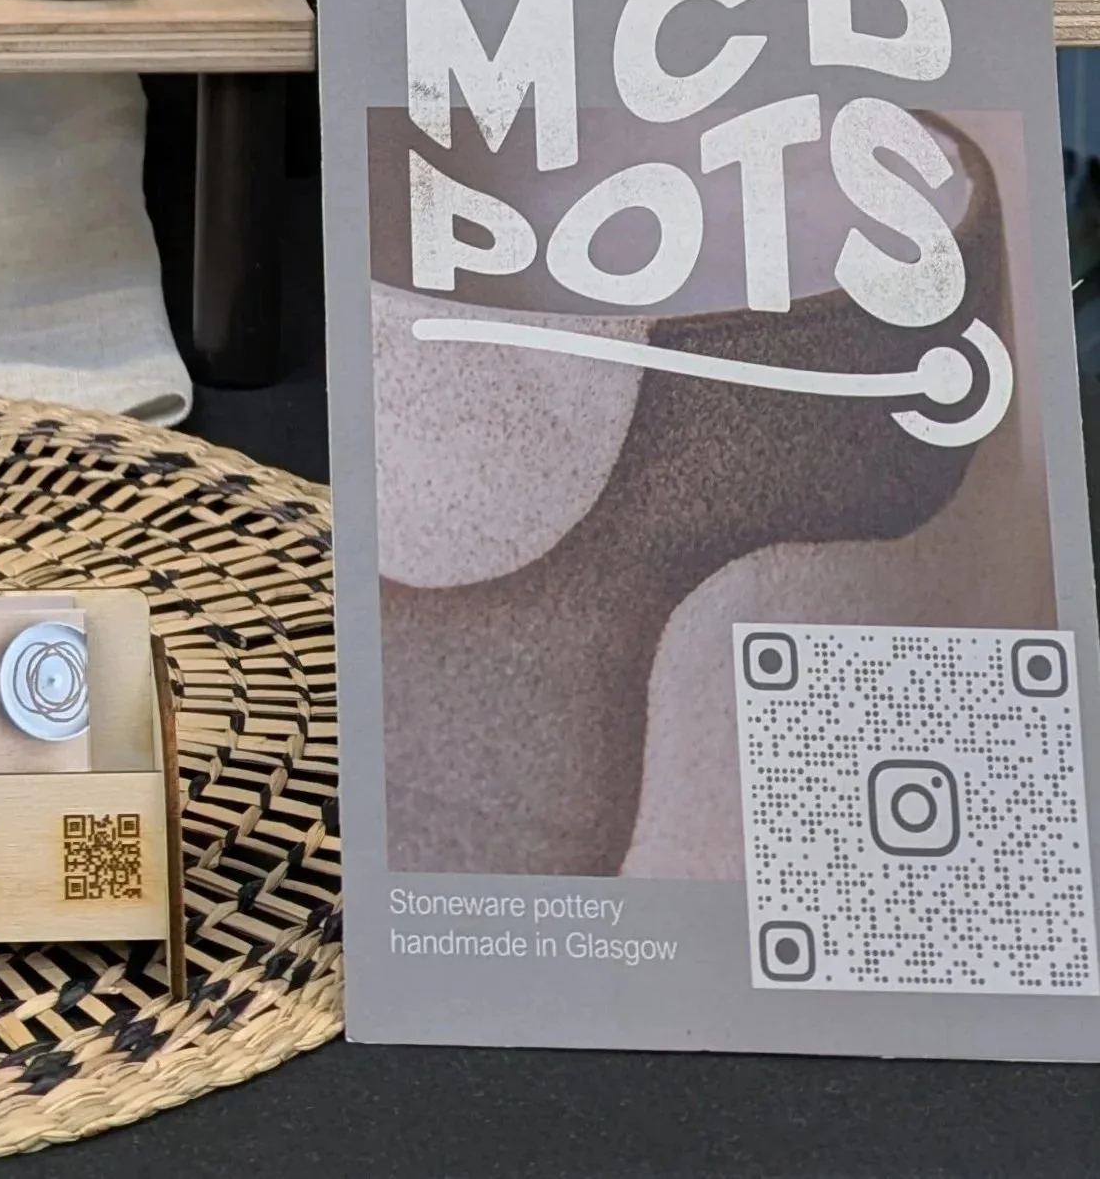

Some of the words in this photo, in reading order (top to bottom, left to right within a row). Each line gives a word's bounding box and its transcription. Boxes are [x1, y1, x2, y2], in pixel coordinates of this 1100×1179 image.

[409, 94, 966, 327] POTS
[390, 888, 525, 917] Stoneware
[534, 894, 624, 925] pottery
[390, 929, 527, 957] handmade
[536, 932, 557, 957] in
[566, 932, 678, 966] Glasgow
